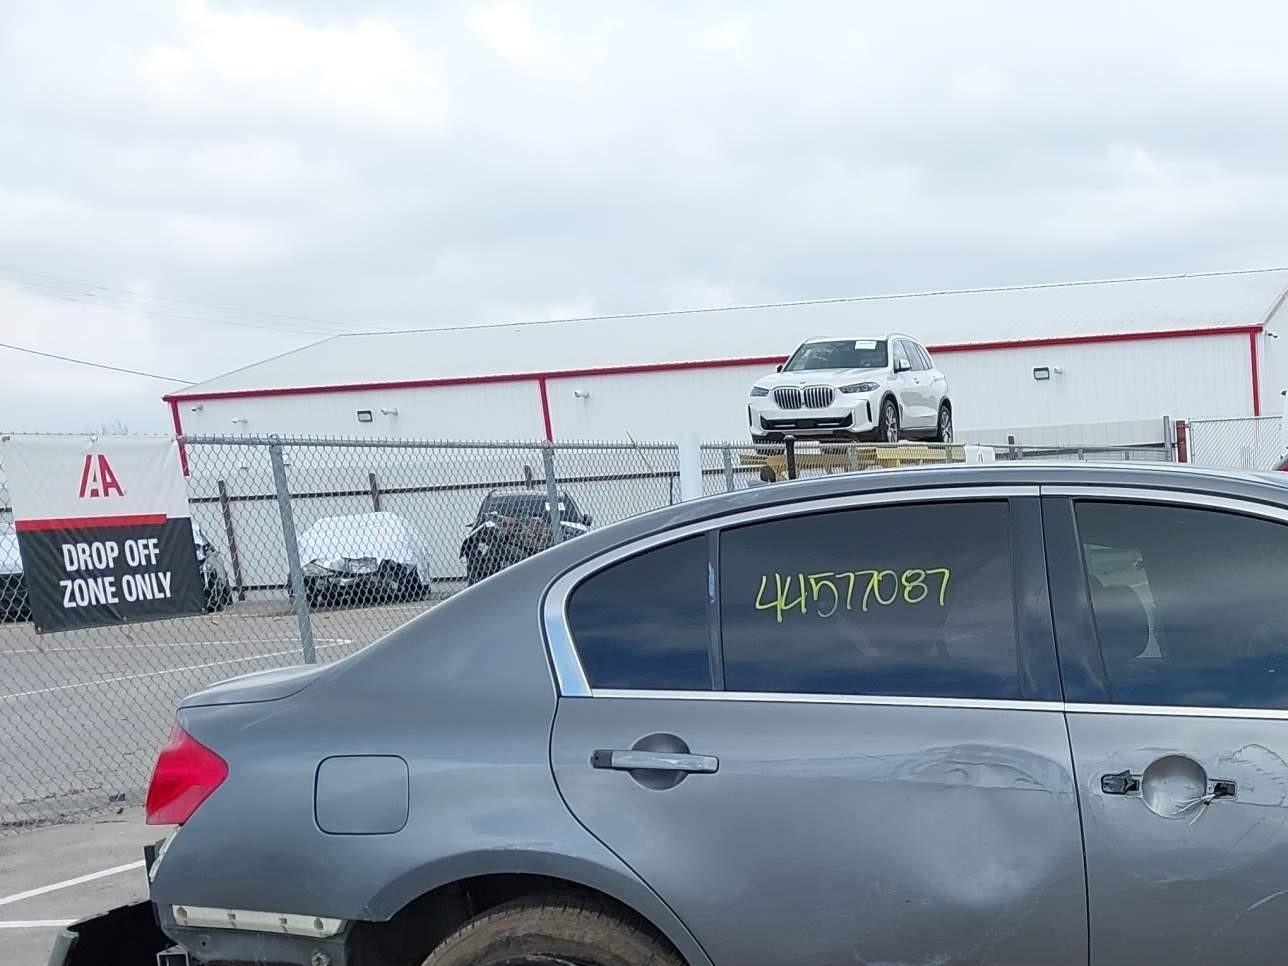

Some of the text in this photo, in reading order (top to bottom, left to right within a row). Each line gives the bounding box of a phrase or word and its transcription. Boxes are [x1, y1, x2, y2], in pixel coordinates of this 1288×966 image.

[61, 538, 160, 572] DROP OFF
[59, 571, 172, 608] ZONE ONLY
[755, 568, 950, 623] 44577087
